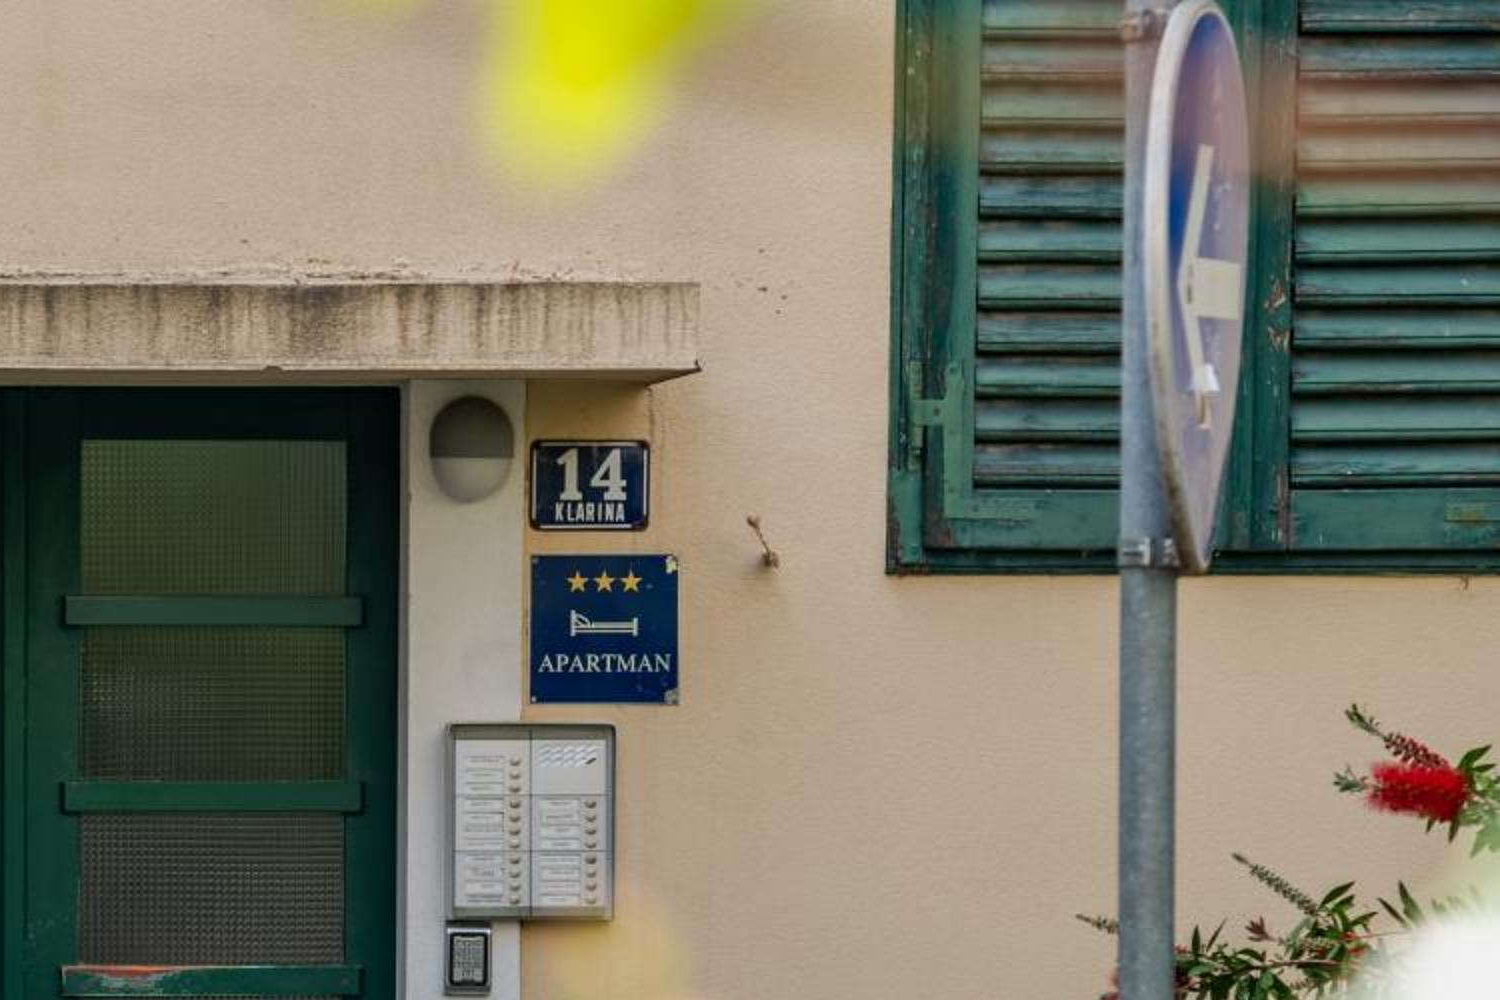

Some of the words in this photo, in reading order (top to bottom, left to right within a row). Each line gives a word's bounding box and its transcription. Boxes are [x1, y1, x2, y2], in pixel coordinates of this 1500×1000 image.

[556, 448, 628, 501] 14
[555, 502, 625, 522] KLARINA
[538, 653, 672, 673] APARTMAN
